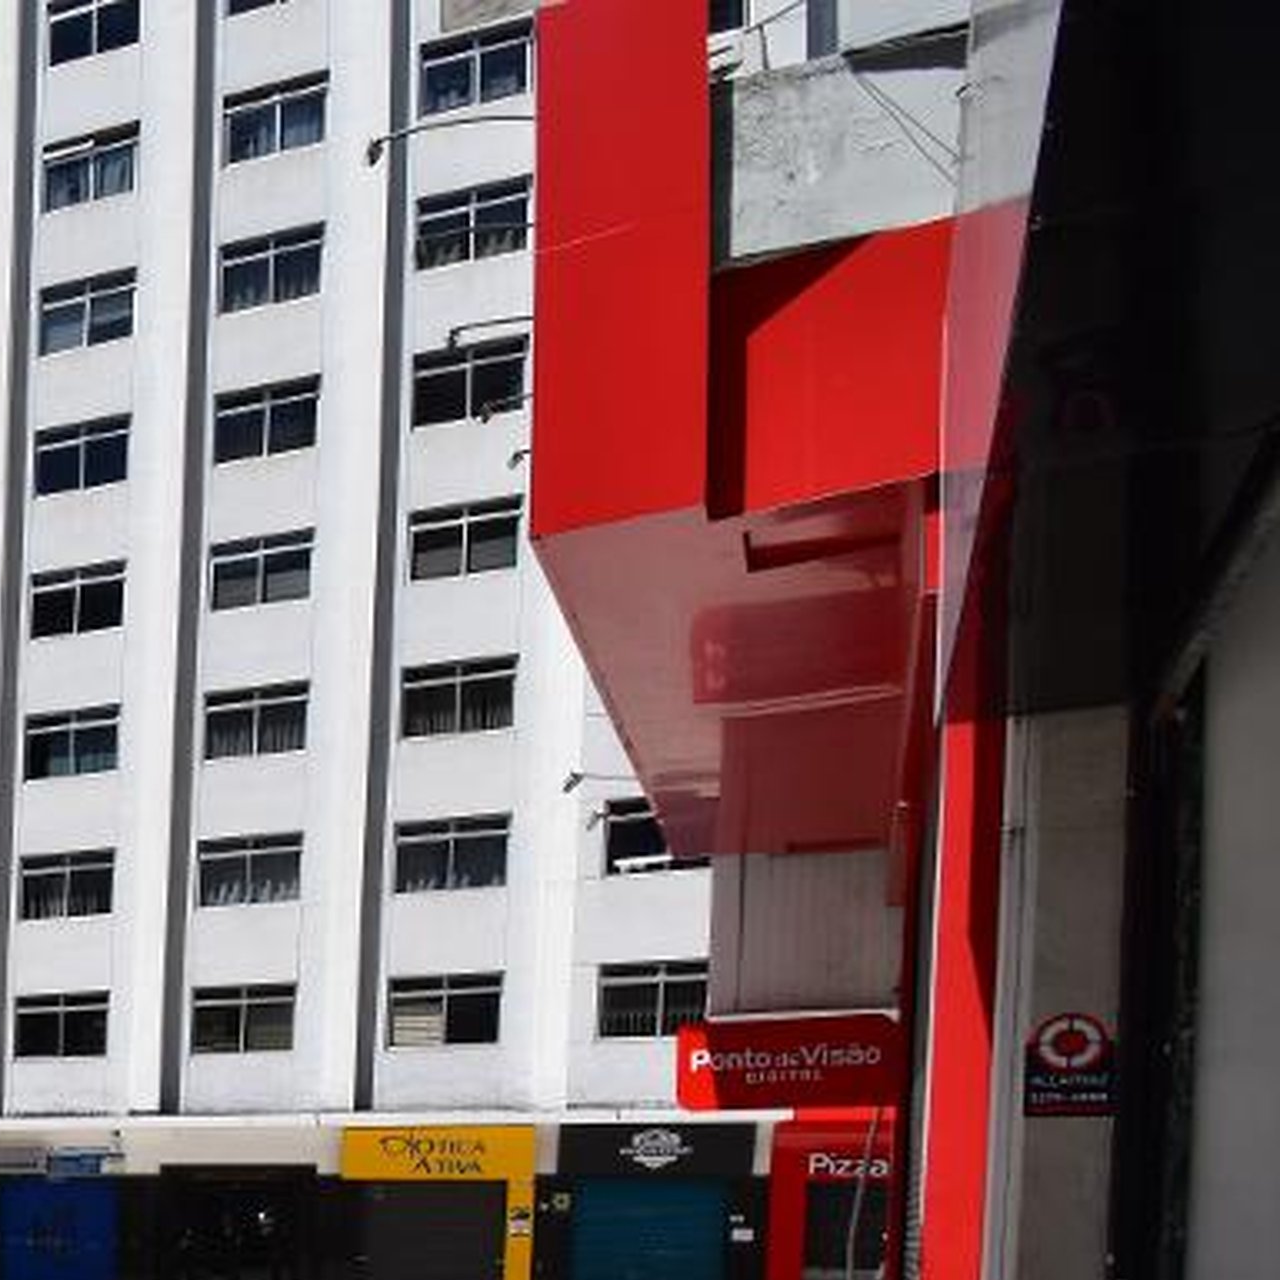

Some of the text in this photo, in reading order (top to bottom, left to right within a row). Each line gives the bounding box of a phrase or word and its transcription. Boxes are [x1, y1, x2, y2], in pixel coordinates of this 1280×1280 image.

[689, 1047, 771, 1073] Ponto
[799, 1043, 882, 1066] Visão
[808, 1152, 889, 1178] Pizza
